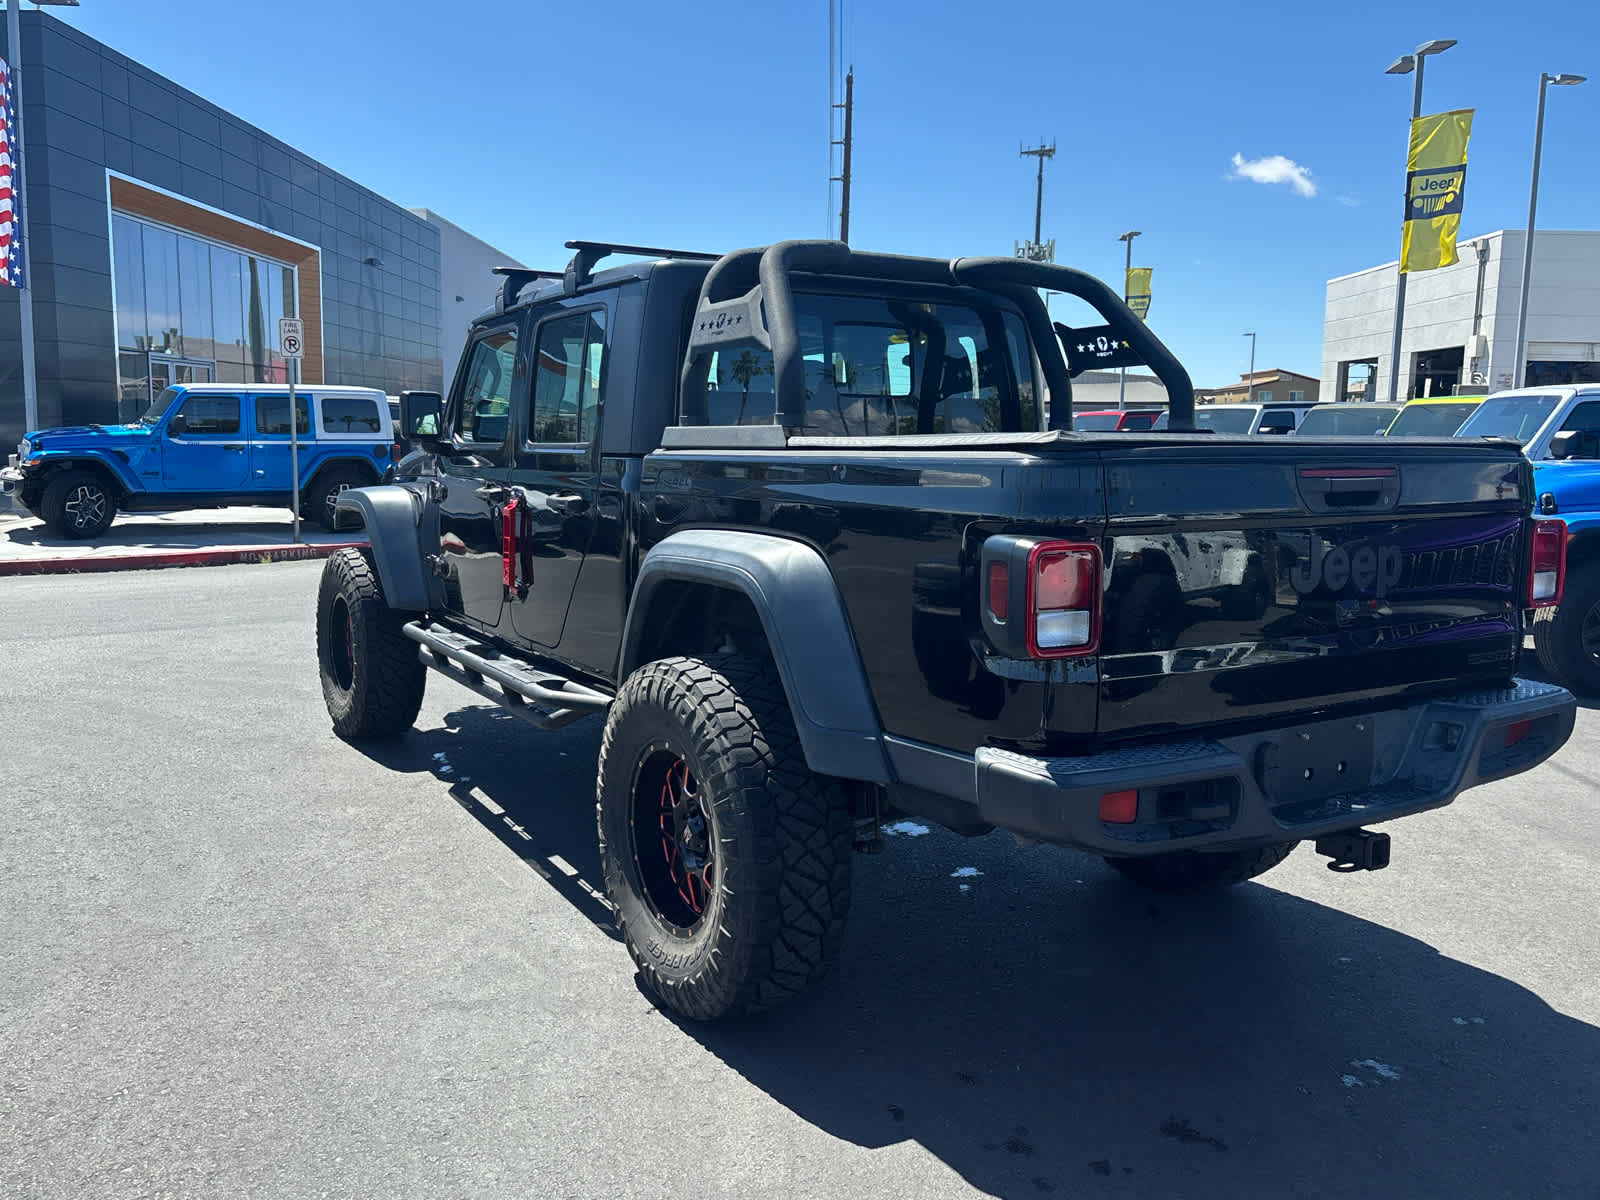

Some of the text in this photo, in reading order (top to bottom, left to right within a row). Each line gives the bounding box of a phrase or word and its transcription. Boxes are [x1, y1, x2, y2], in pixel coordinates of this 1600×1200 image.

[1420, 176, 1458, 191] Jeep
[240, 548, 317, 562] NO PARKING
[1290, 535, 1402, 598] Jeep
